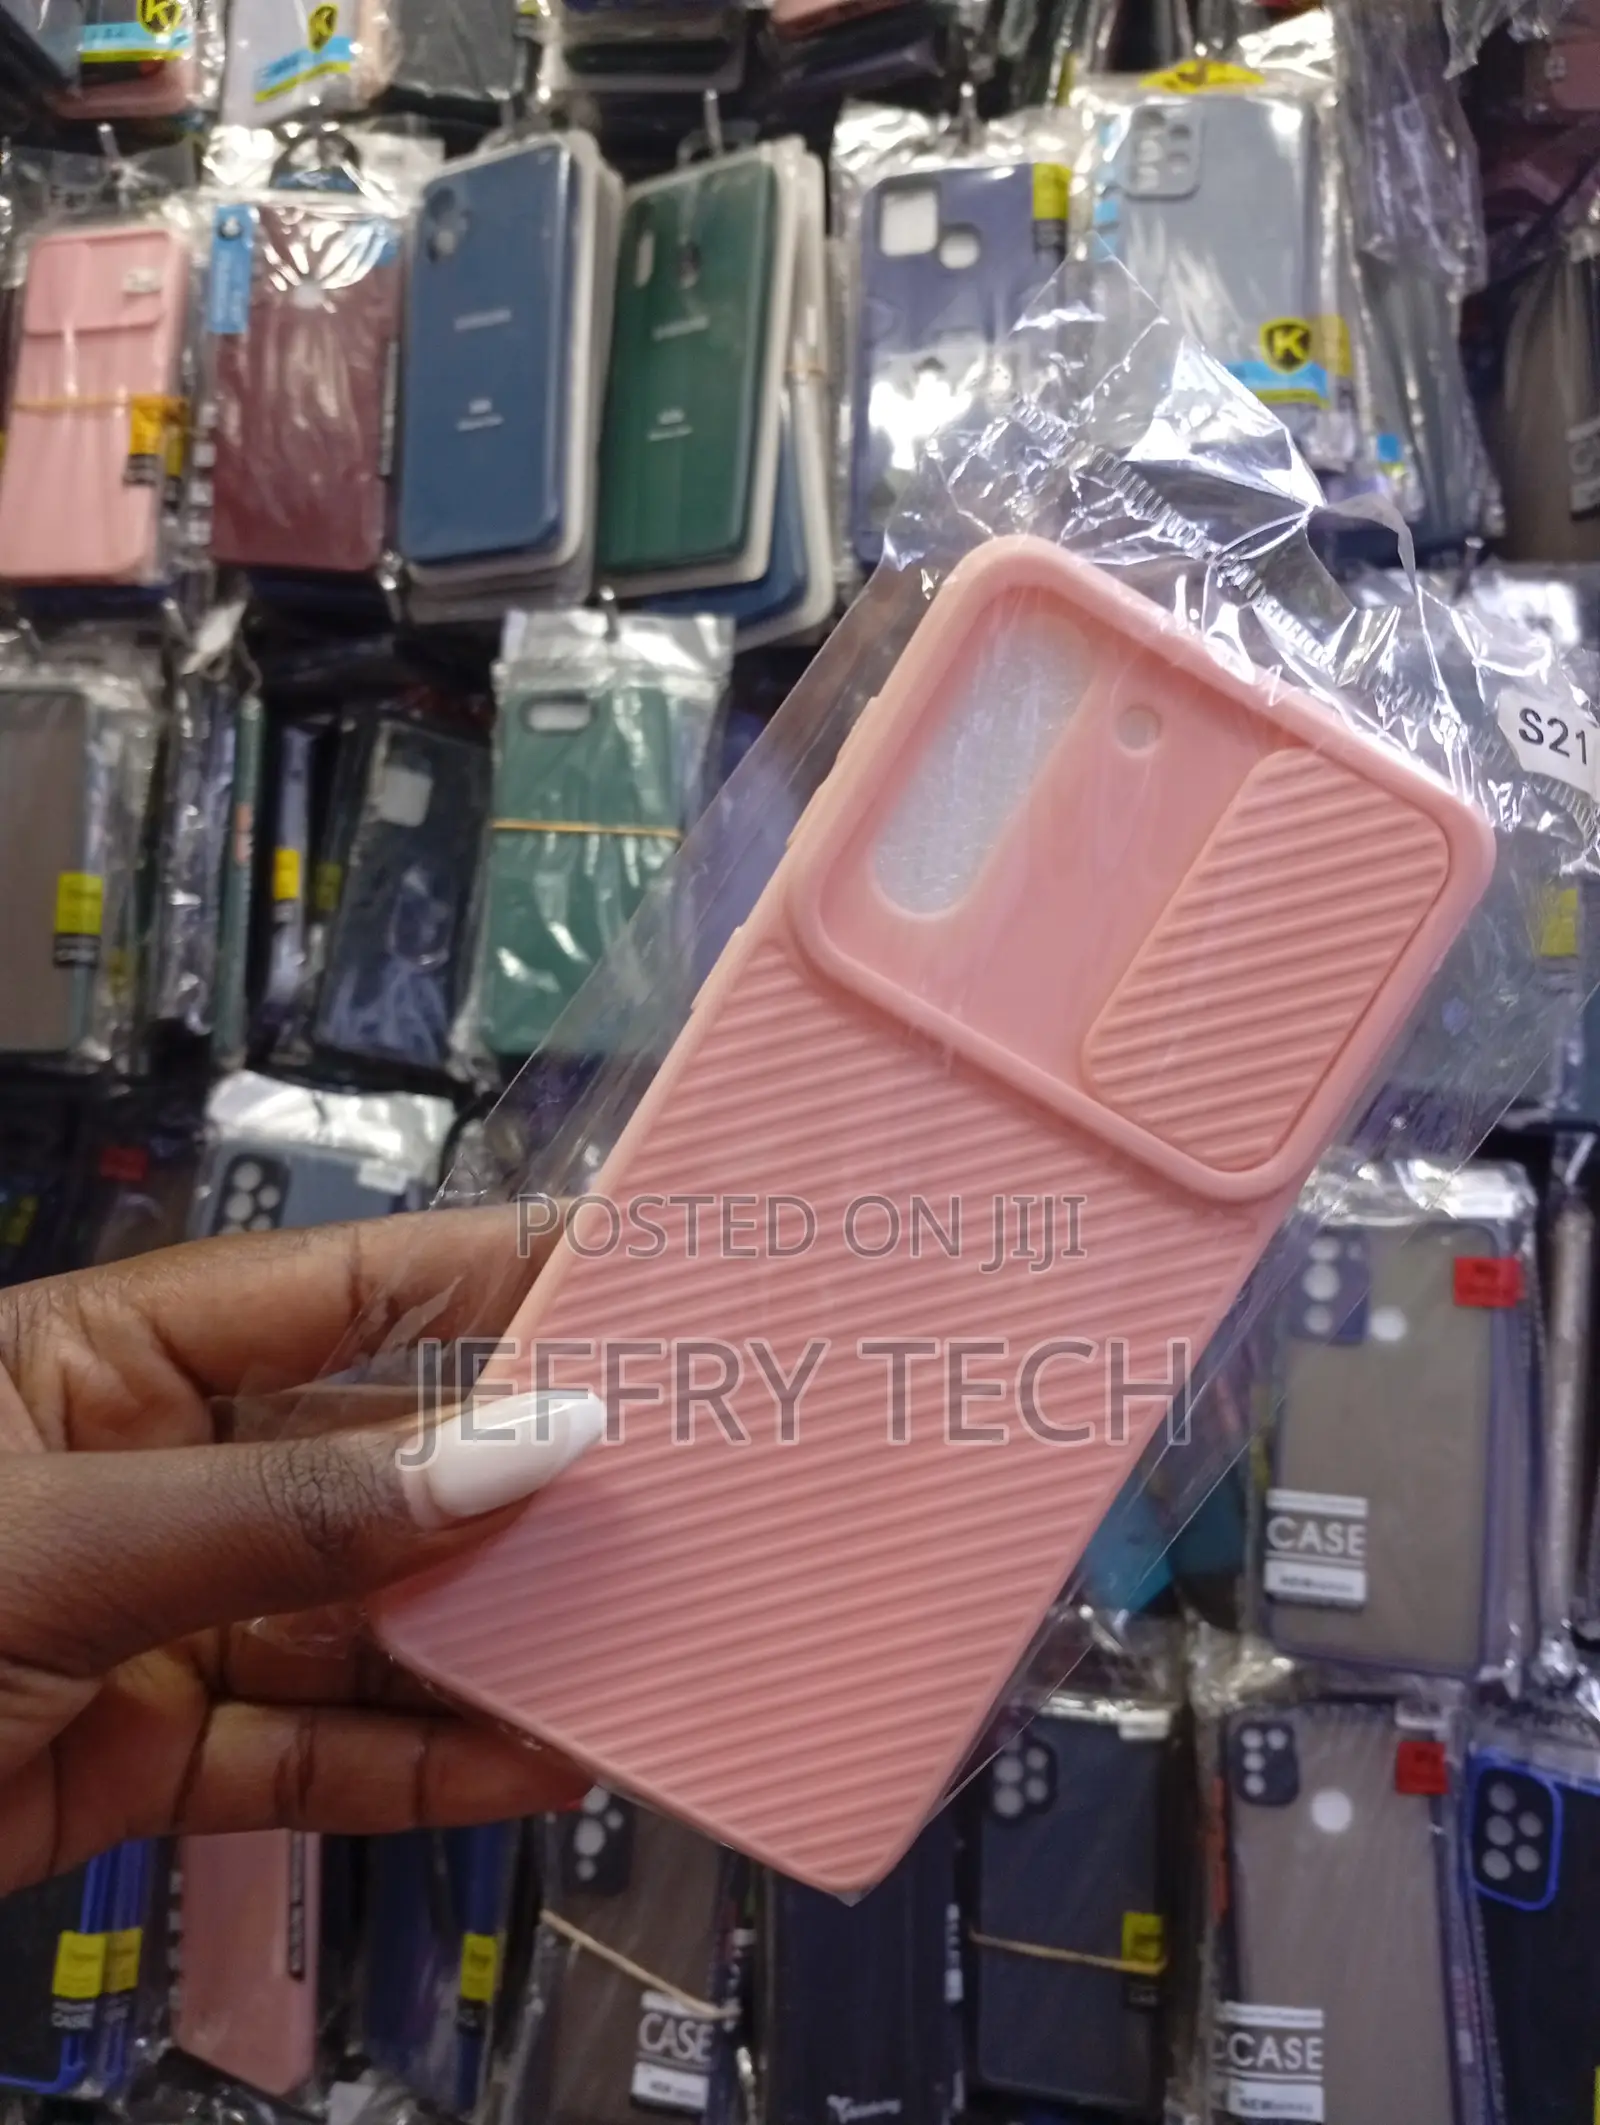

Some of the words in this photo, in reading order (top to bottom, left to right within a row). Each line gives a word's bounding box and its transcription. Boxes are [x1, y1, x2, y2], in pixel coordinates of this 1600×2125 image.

[1519, 707, 1587, 766] S21
[1266, 1516, 1366, 1557] CASE
[639, 2012, 714, 2062] CASE
[1228, 2031, 1323, 2071] CASE
